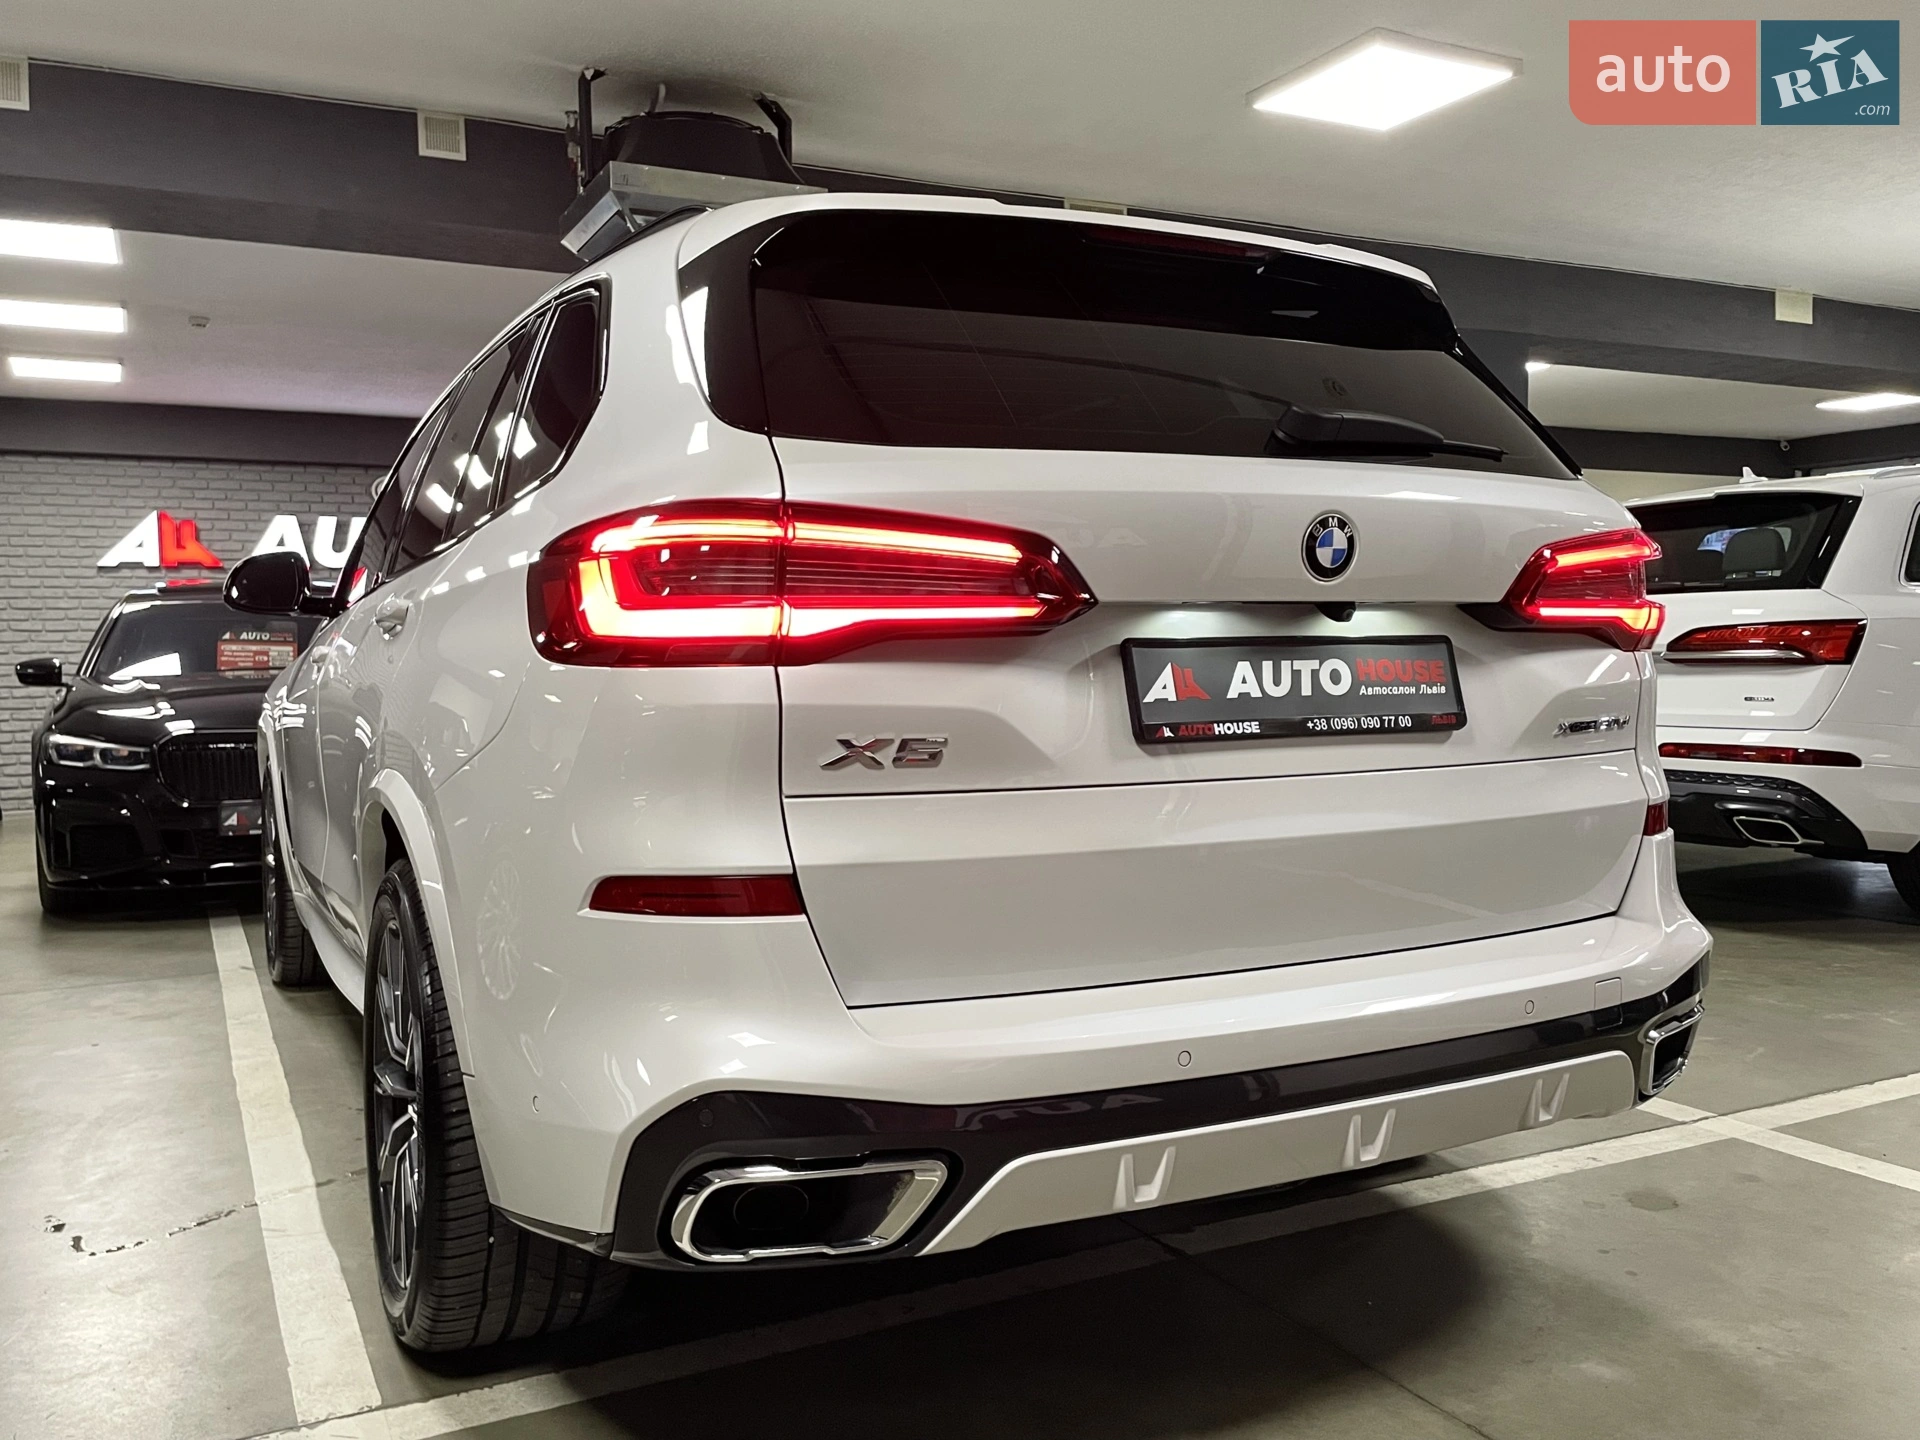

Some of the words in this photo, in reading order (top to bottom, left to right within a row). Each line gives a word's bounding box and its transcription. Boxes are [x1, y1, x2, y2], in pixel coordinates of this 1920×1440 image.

[1312, 516, 1353, 538] BMW
[240, 631, 270, 640] AUTO
[1226, 658, 1352, 698] AUTO
[1355, 658, 1447, 683] HOUSE
[1359, 684, 1416, 696] Автосалон
[1419, 683, 1447, 695] Львів
[1306, 718, 1328, 731] +38
[1330, 716, 1358, 730] (096)
[1361, 716, 1381, 729] 090
[1382, 716, 1396, 728] 77
[1398, 715, 1412, 728] 00
